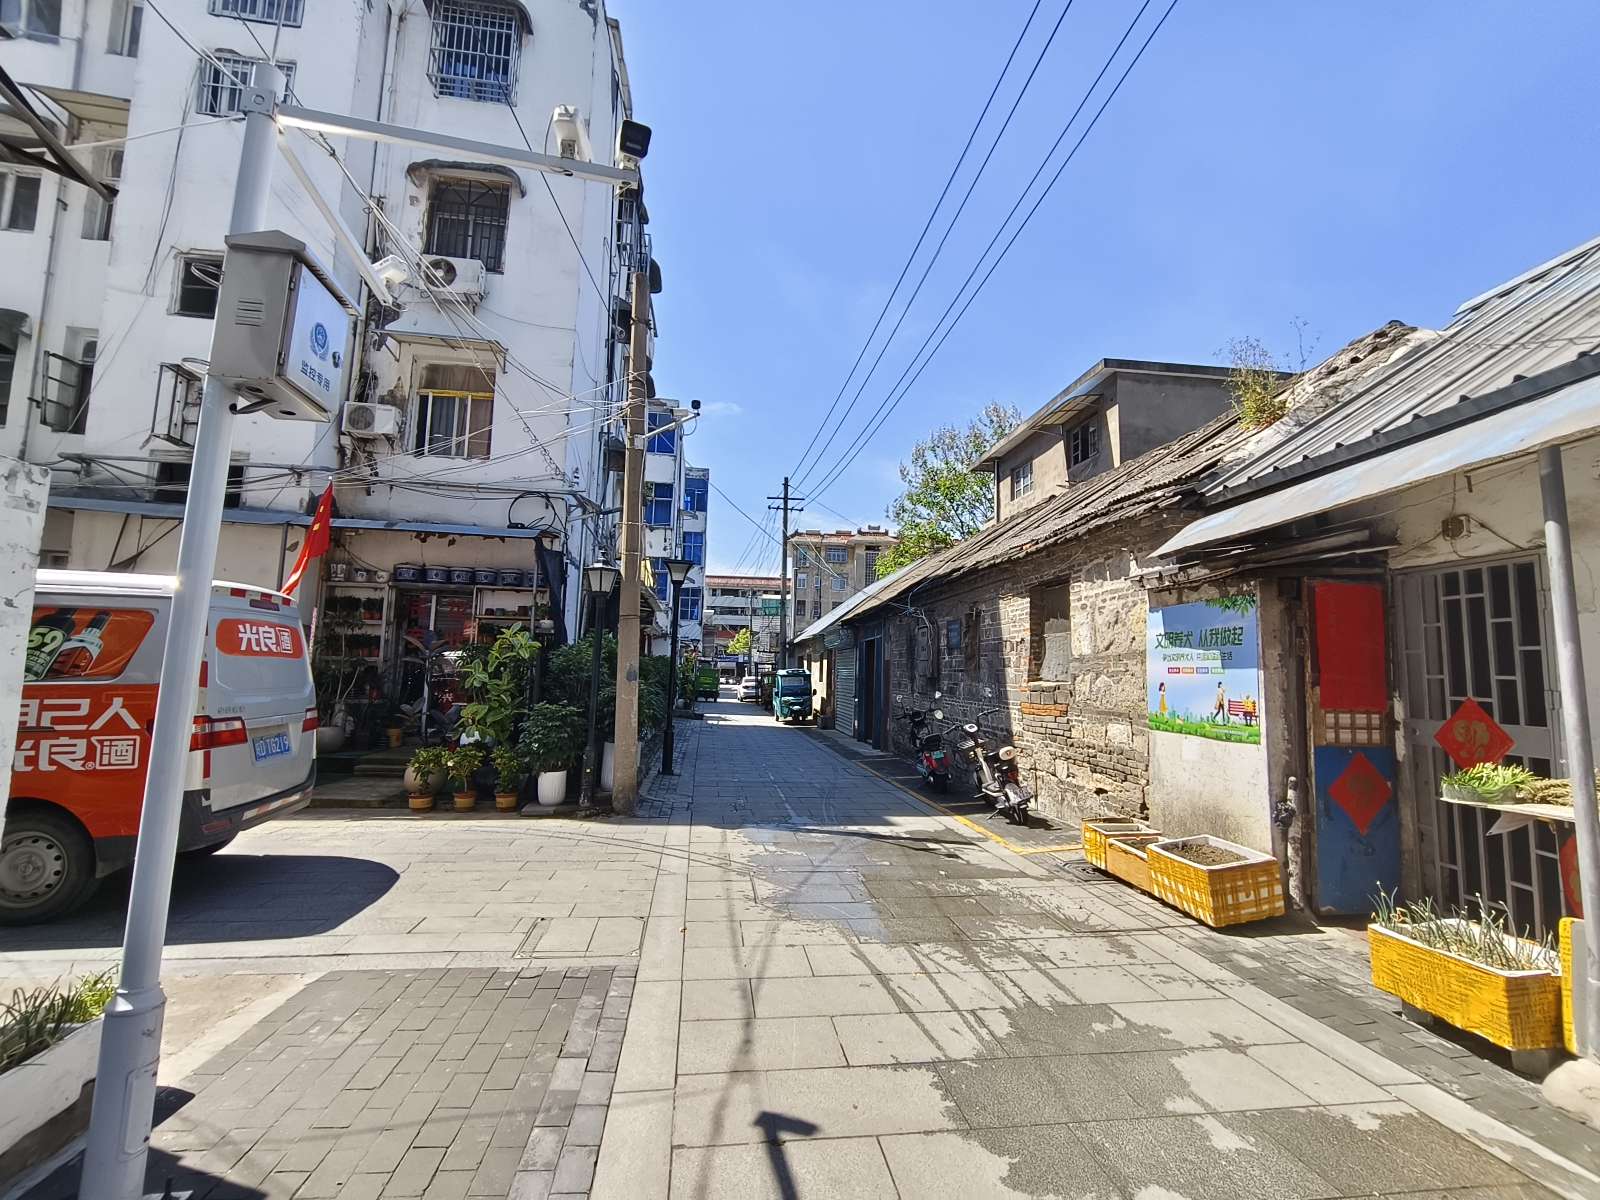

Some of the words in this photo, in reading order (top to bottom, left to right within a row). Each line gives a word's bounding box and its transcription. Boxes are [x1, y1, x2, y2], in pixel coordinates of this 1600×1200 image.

[300, 359, 330, 392] 监控专用
[1155, 630, 1193, 648] 文明养犬
[1198, 626, 1244, 648] 从我做起
